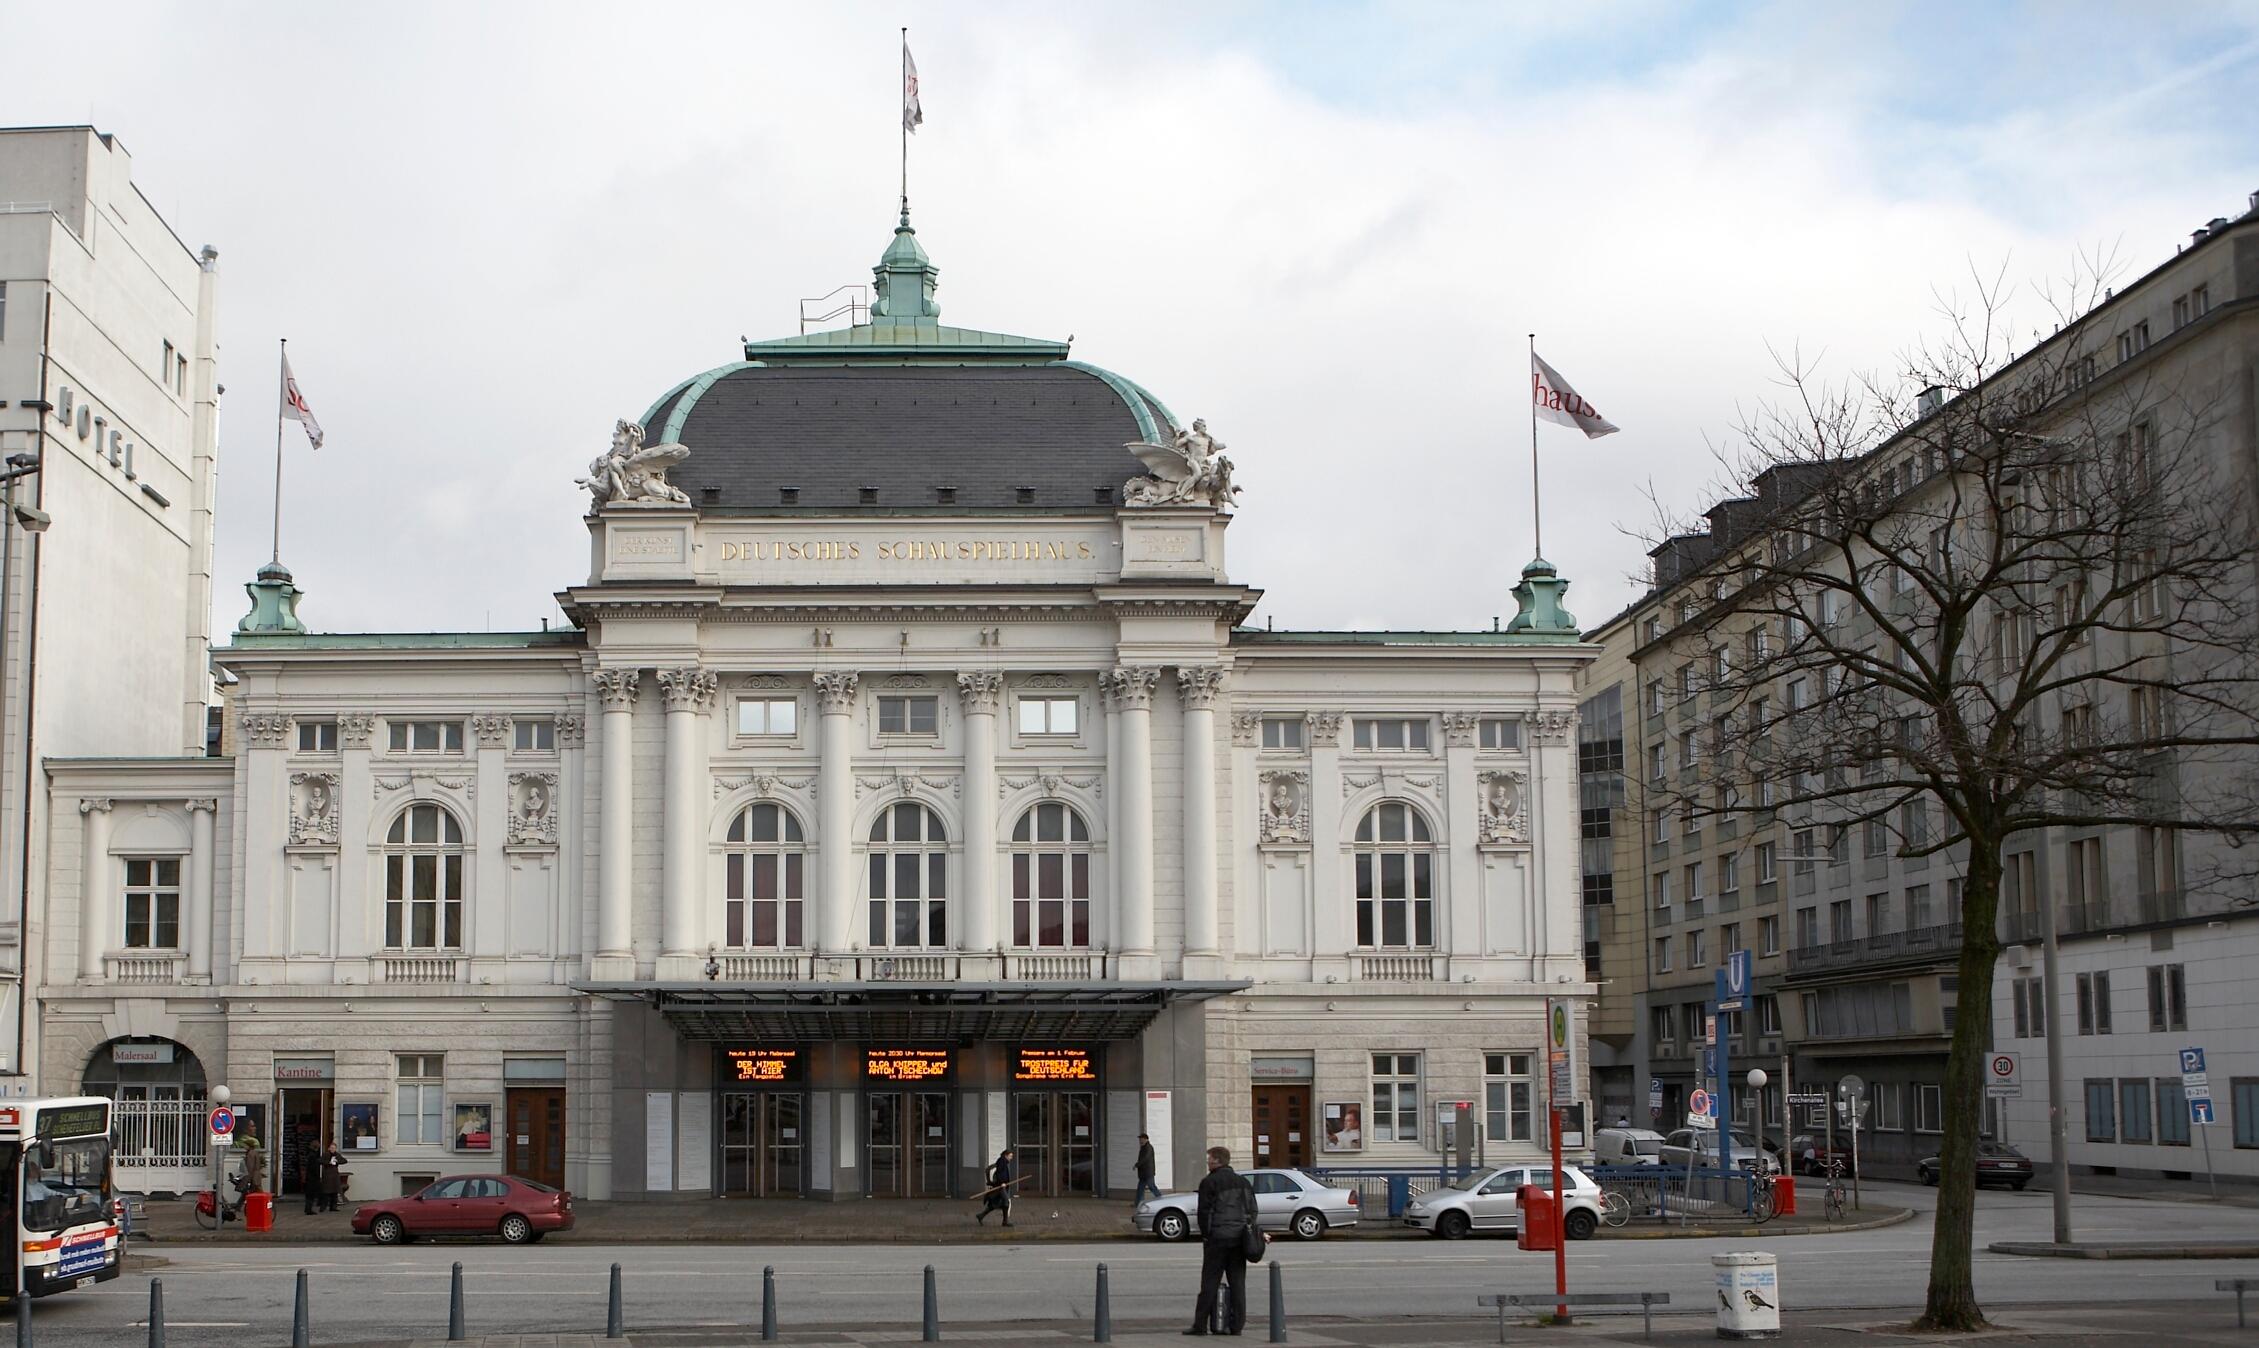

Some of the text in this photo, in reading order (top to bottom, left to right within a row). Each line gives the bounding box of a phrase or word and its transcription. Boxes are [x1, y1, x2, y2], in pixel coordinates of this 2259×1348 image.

[1533, 372, 1603, 421] haus.
[59, 385, 137, 481] HOTEL
[721, 542, 861, 561] DEUTSCHES
[1730, 955, 1743, 993] U
[114, 1050, 157, 1061] Malersaal
[868, 1060, 948, 1068] OLGA KNIPPER und
[1998, 1061, 2009, 1072] 30
[277, 1066, 322, 1078] Kantine
[868, 1067, 895, 1075] ANTON
[1789, 1096, 1824, 1104] Kirchenallee
